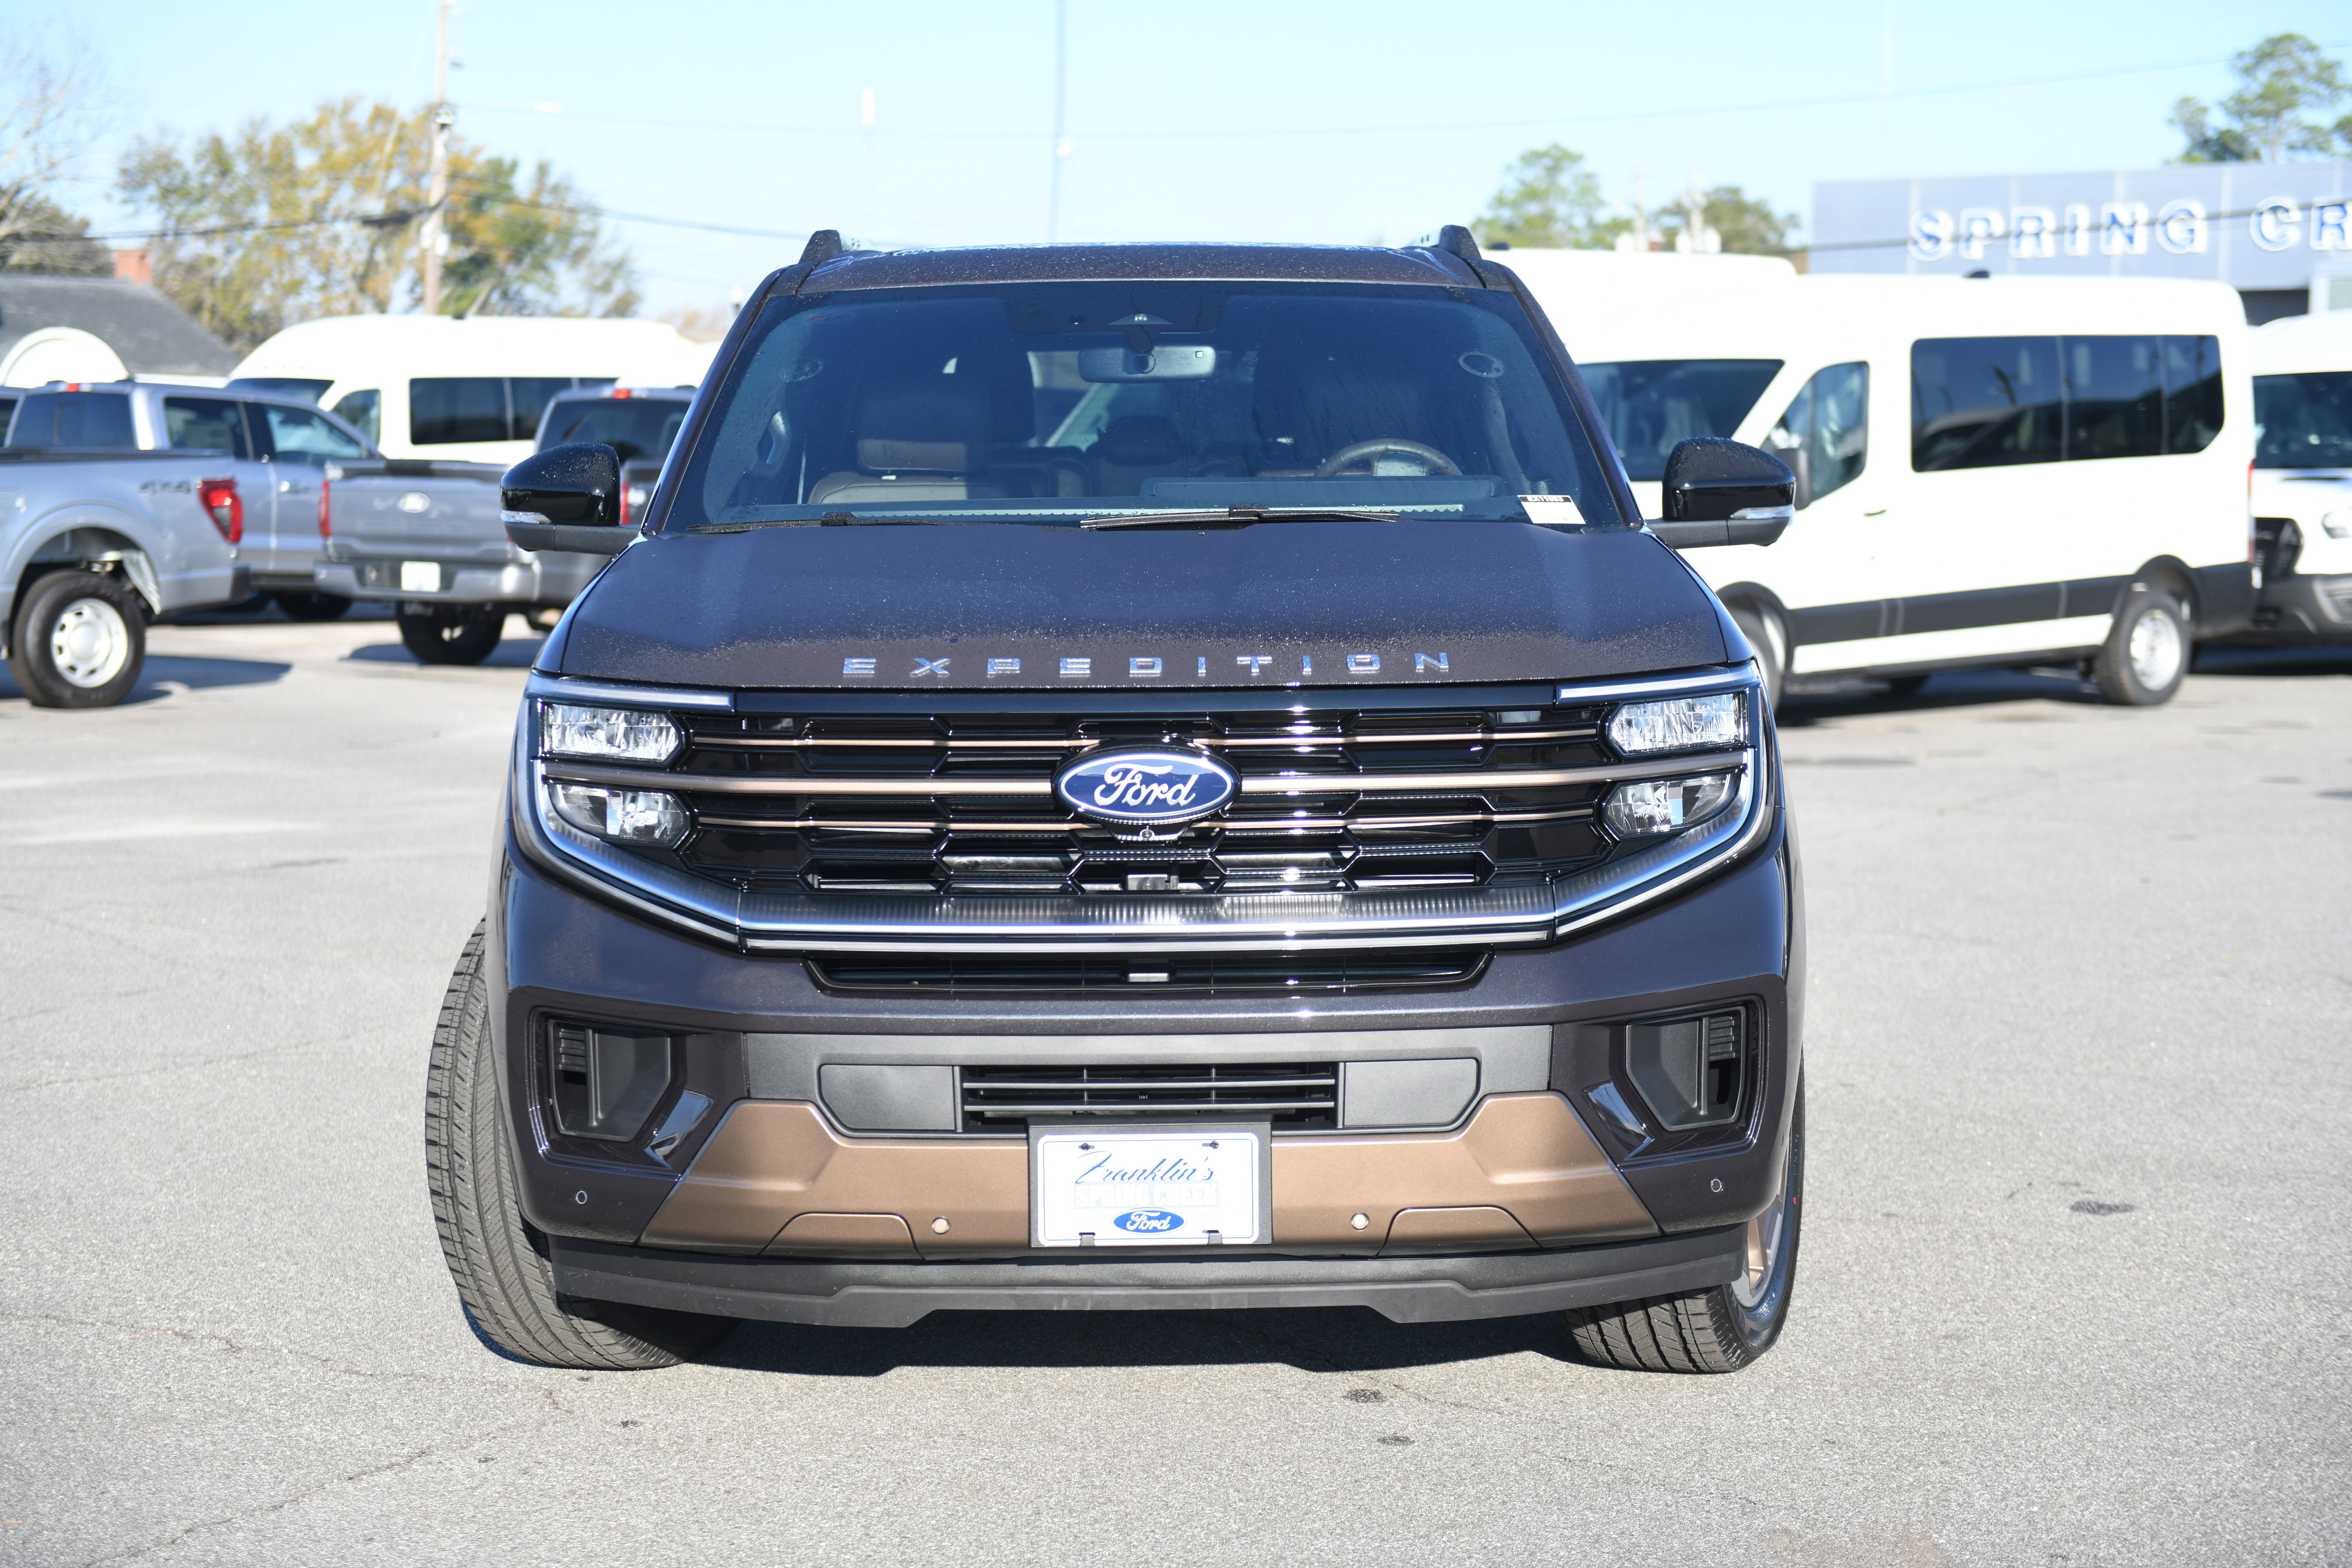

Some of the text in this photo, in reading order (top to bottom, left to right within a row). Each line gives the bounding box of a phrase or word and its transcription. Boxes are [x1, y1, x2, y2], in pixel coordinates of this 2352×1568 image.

[1908, 199, 2206, 262] SPRING
[842, 653, 1449, 677] EXPEDITION
[1094, 763, 1199, 806] Ford
[1075, 1150, 1215, 1184] Franklin's
[1075, 1183, 1218, 1207] SPRING CREEK
[1126, 1211, 1171, 1230] Ford
